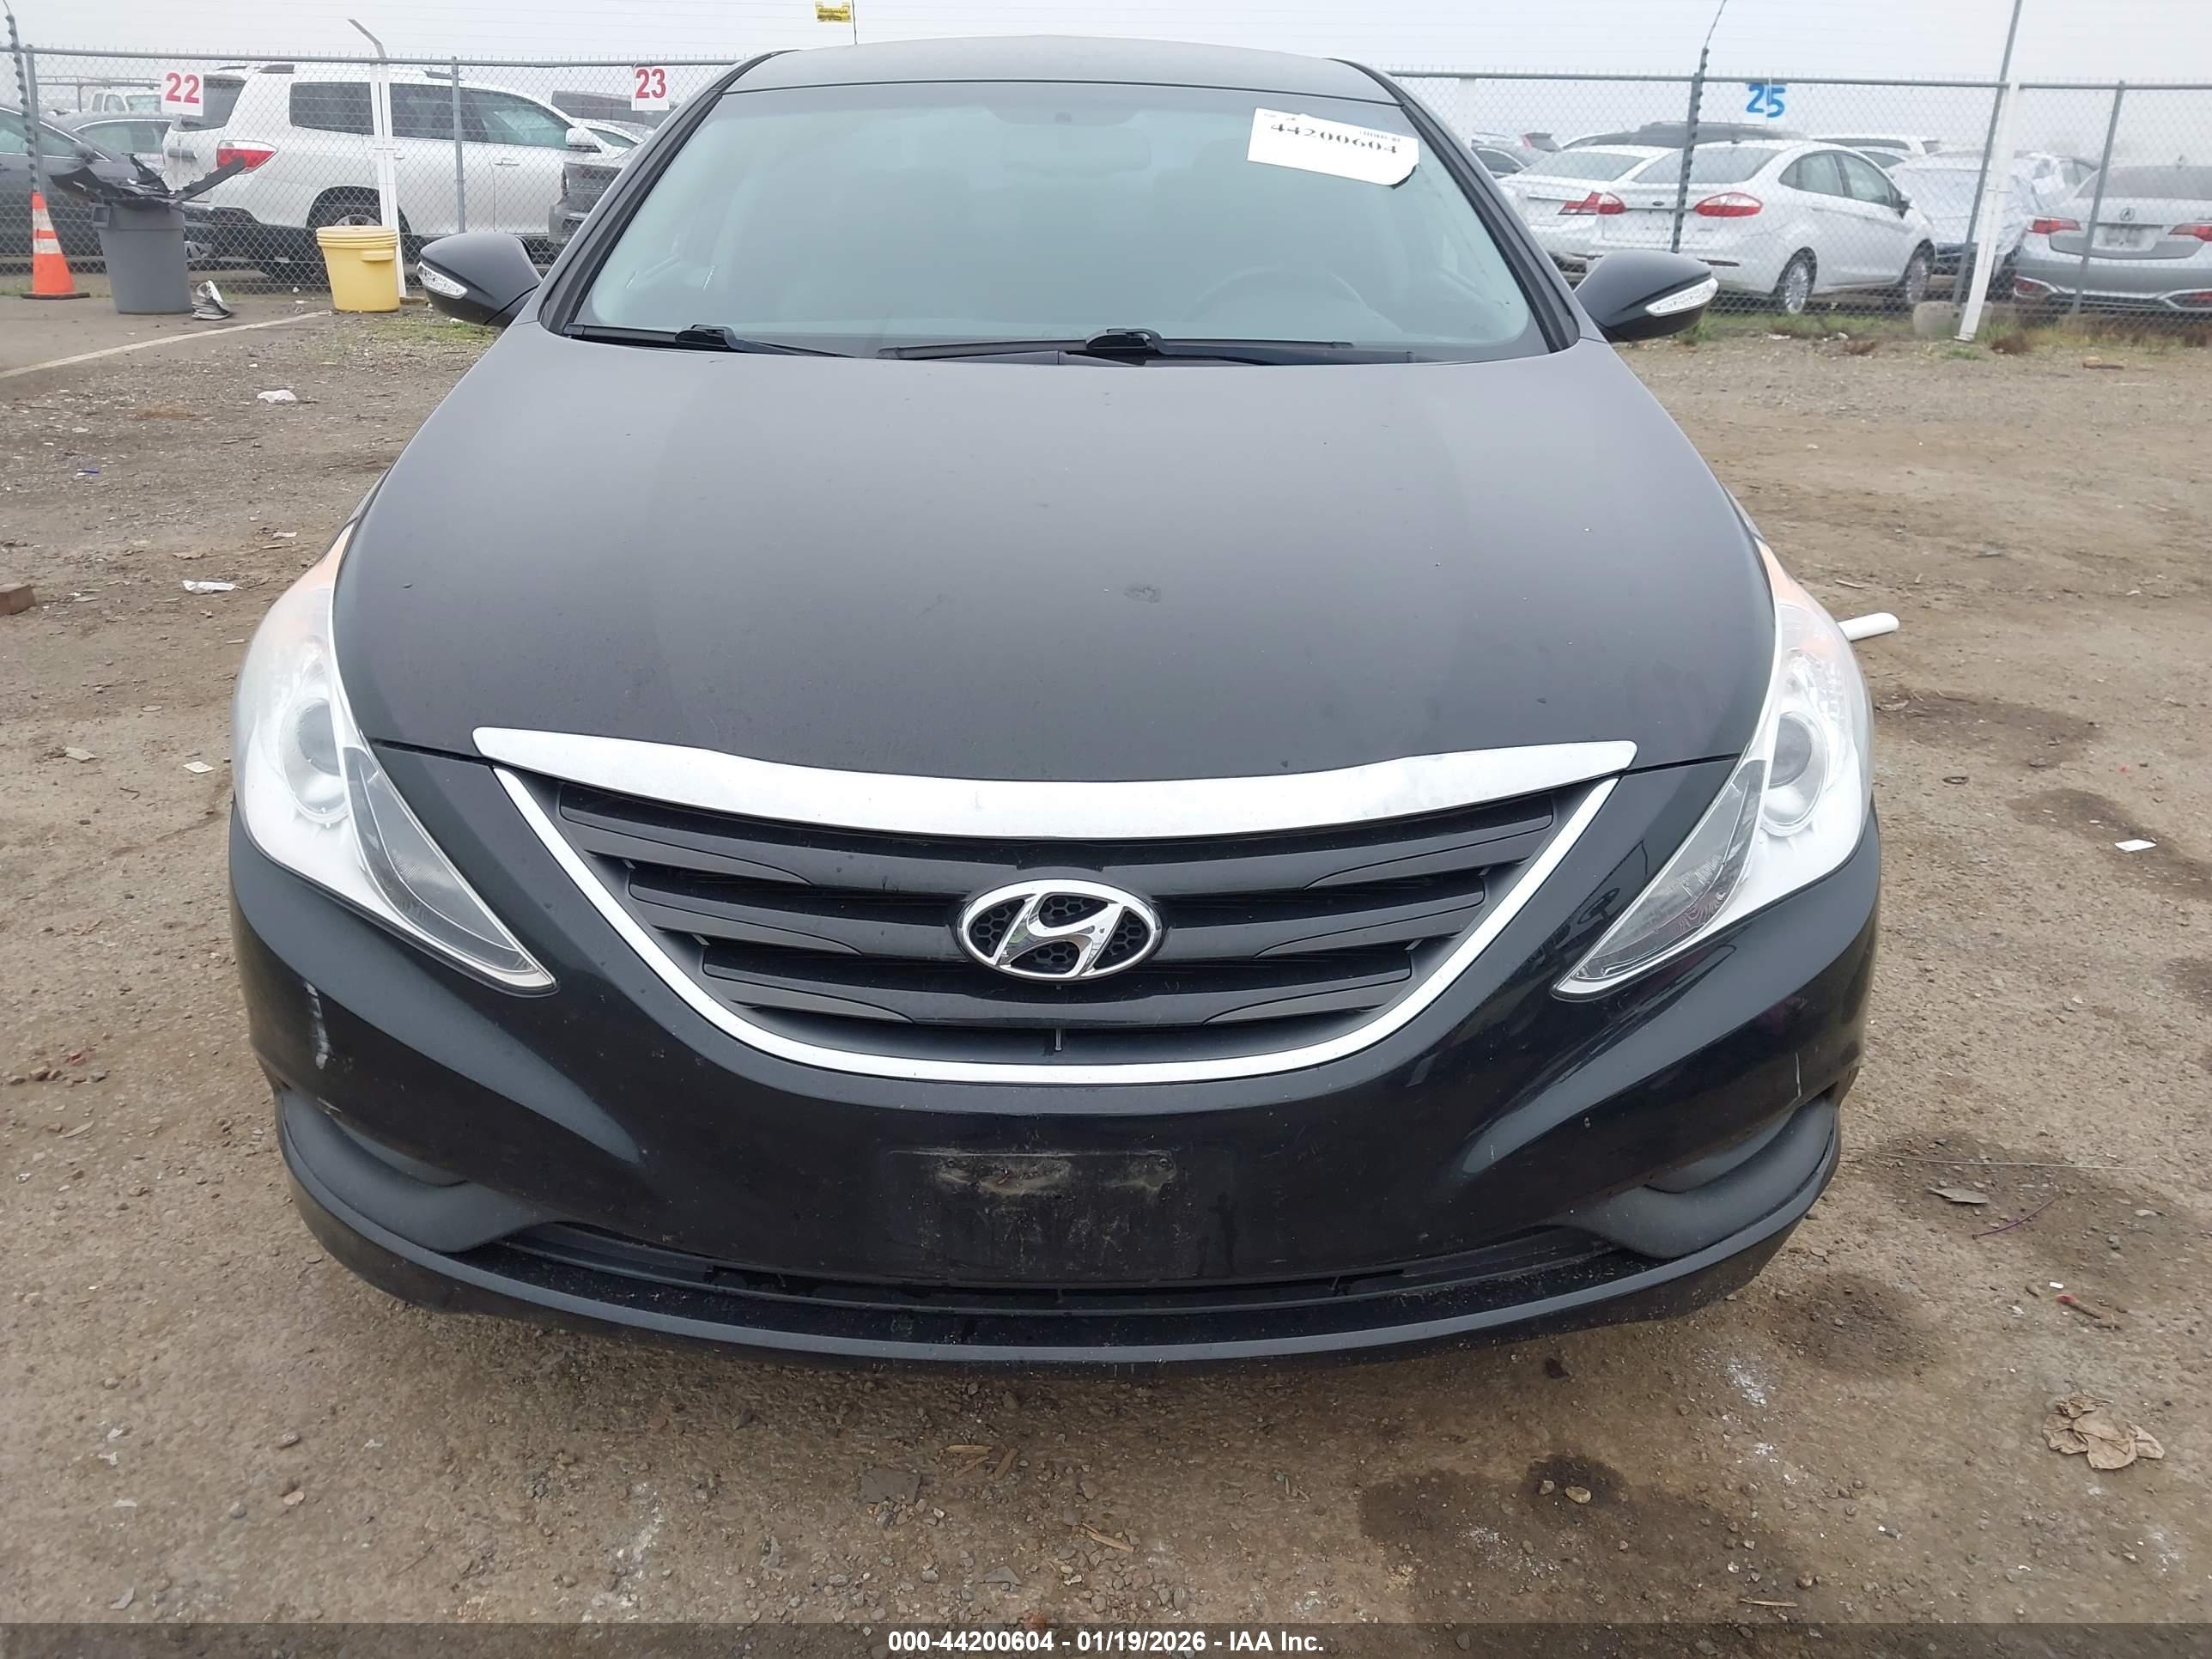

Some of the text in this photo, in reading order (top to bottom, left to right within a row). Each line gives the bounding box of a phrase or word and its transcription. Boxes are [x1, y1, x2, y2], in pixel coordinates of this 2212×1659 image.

[165, 72, 200, 104] 22
[635, 68, 666, 99] 23
[1746, 82, 1786, 118] 25
[1270, 123, 1398, 154] 44200604
